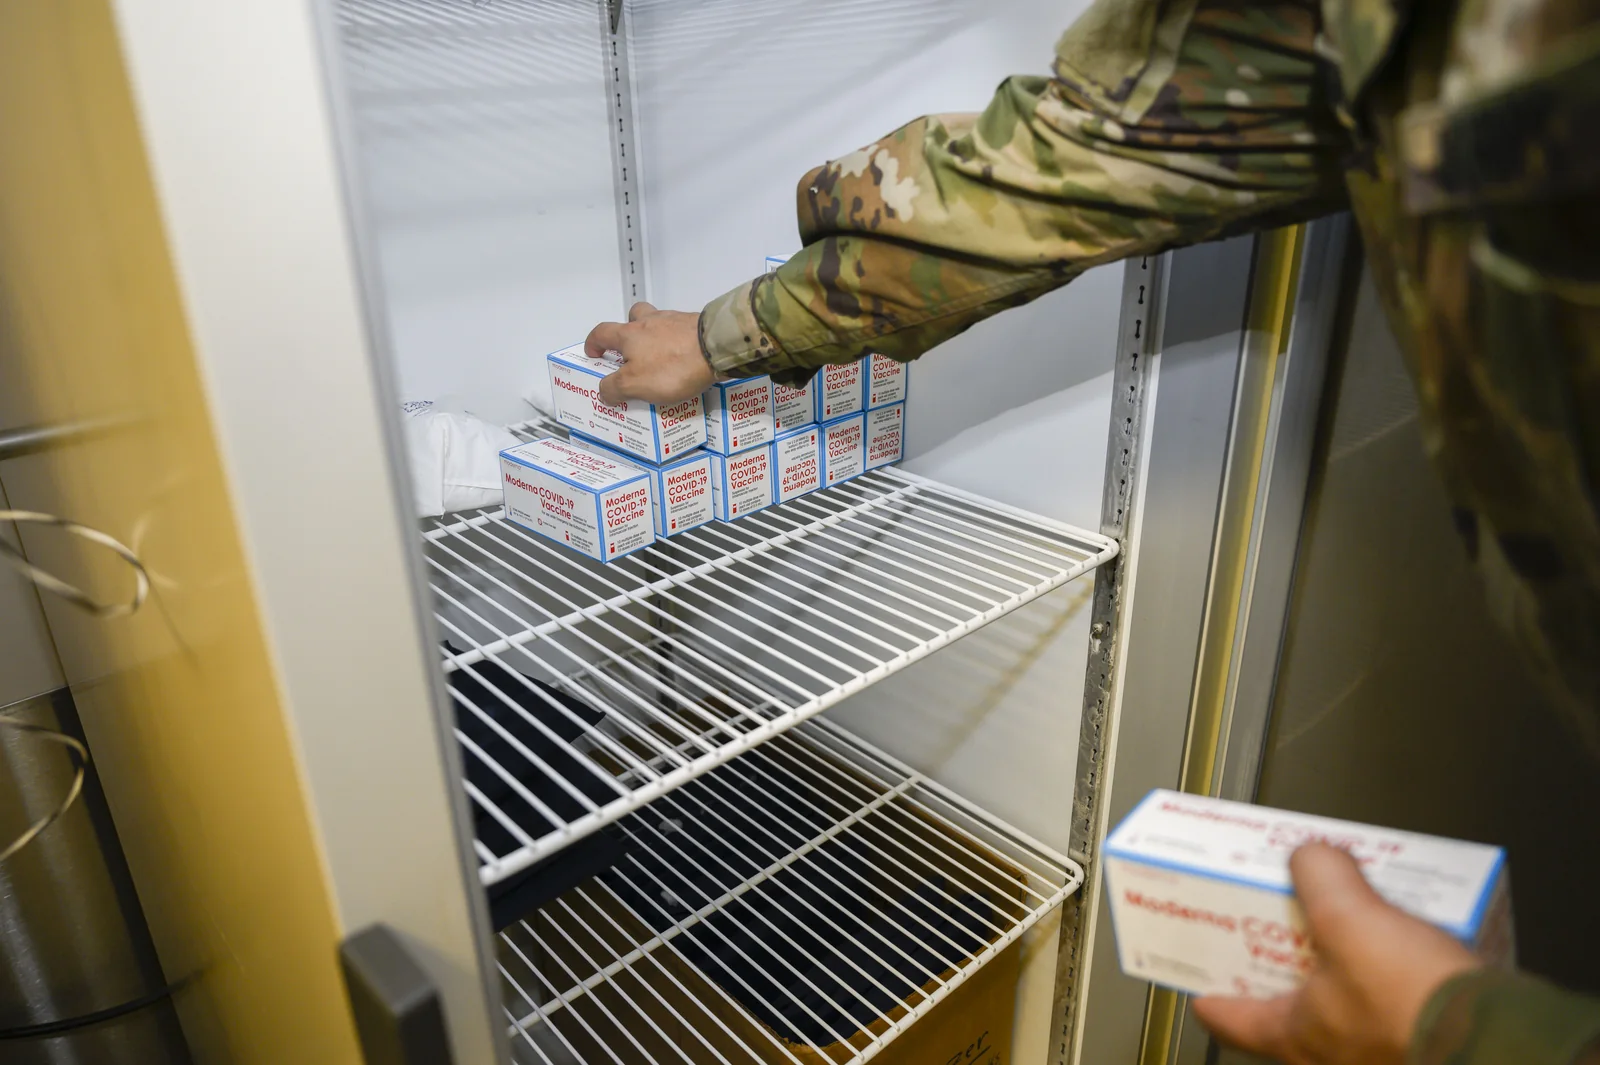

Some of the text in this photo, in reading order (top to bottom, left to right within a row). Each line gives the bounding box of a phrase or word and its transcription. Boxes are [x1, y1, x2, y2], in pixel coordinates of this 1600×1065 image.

[826, 366, 859, 383] COVID-19
[873, 367, 901, 380] Vaccine
[554, 376, 589, 397] Moderna
[826, 377, 856, 391] Vaccine
[730, 385, 767, 402] Moderna
[774, 389, 807, 404] Vaccine
[592, 400, 625, 422] Vaccine
[660, 397, 699, 421] COVID-19
[730, 394, 768, 412] COVID-19
[661, 408, 697, 429] Vaccine
[731, 406, 766, 421] Vaccine
[828, 425, 860, 441] Moderna
[828, 432, 860, 450] COVID-19
[872, 431, 900, 444] Vaccine
[541, 441, 577, 456] Moderna
[575, 452, 617, 469] COVID-19
[828, 443, 858, 458] Vaccine
[869, 438, 900, 454] COVID-19
[869, 447, 899, 461] Moderna
[567, 456, 600, 471] Vaccine
[730, 453, 766, 472] Moderna
[785, 458, 816, 474] Vaccine
[667, 467, 706, 487] Moderna
[730, 462, 767, 482] COVID-19
[782, 466, 817, 485] COVID-19
[668, 475, 708, 496] COVID-19
[731, 473, 764, 490] Vaccine
[783, 476, 817, 493] Moderna
[505, 473, 575, 510] Moderna COVID-19
[605, 488, 646, 509] Moderna
[669, 487, 705, 505] Vaccine
[540, 498, 572, 520] Vaccine
[606, 497, 648, 519] COVID-19
[607, 509, 645, 528] Vaccine
[1122, 888, 1236, 934] Moderna
